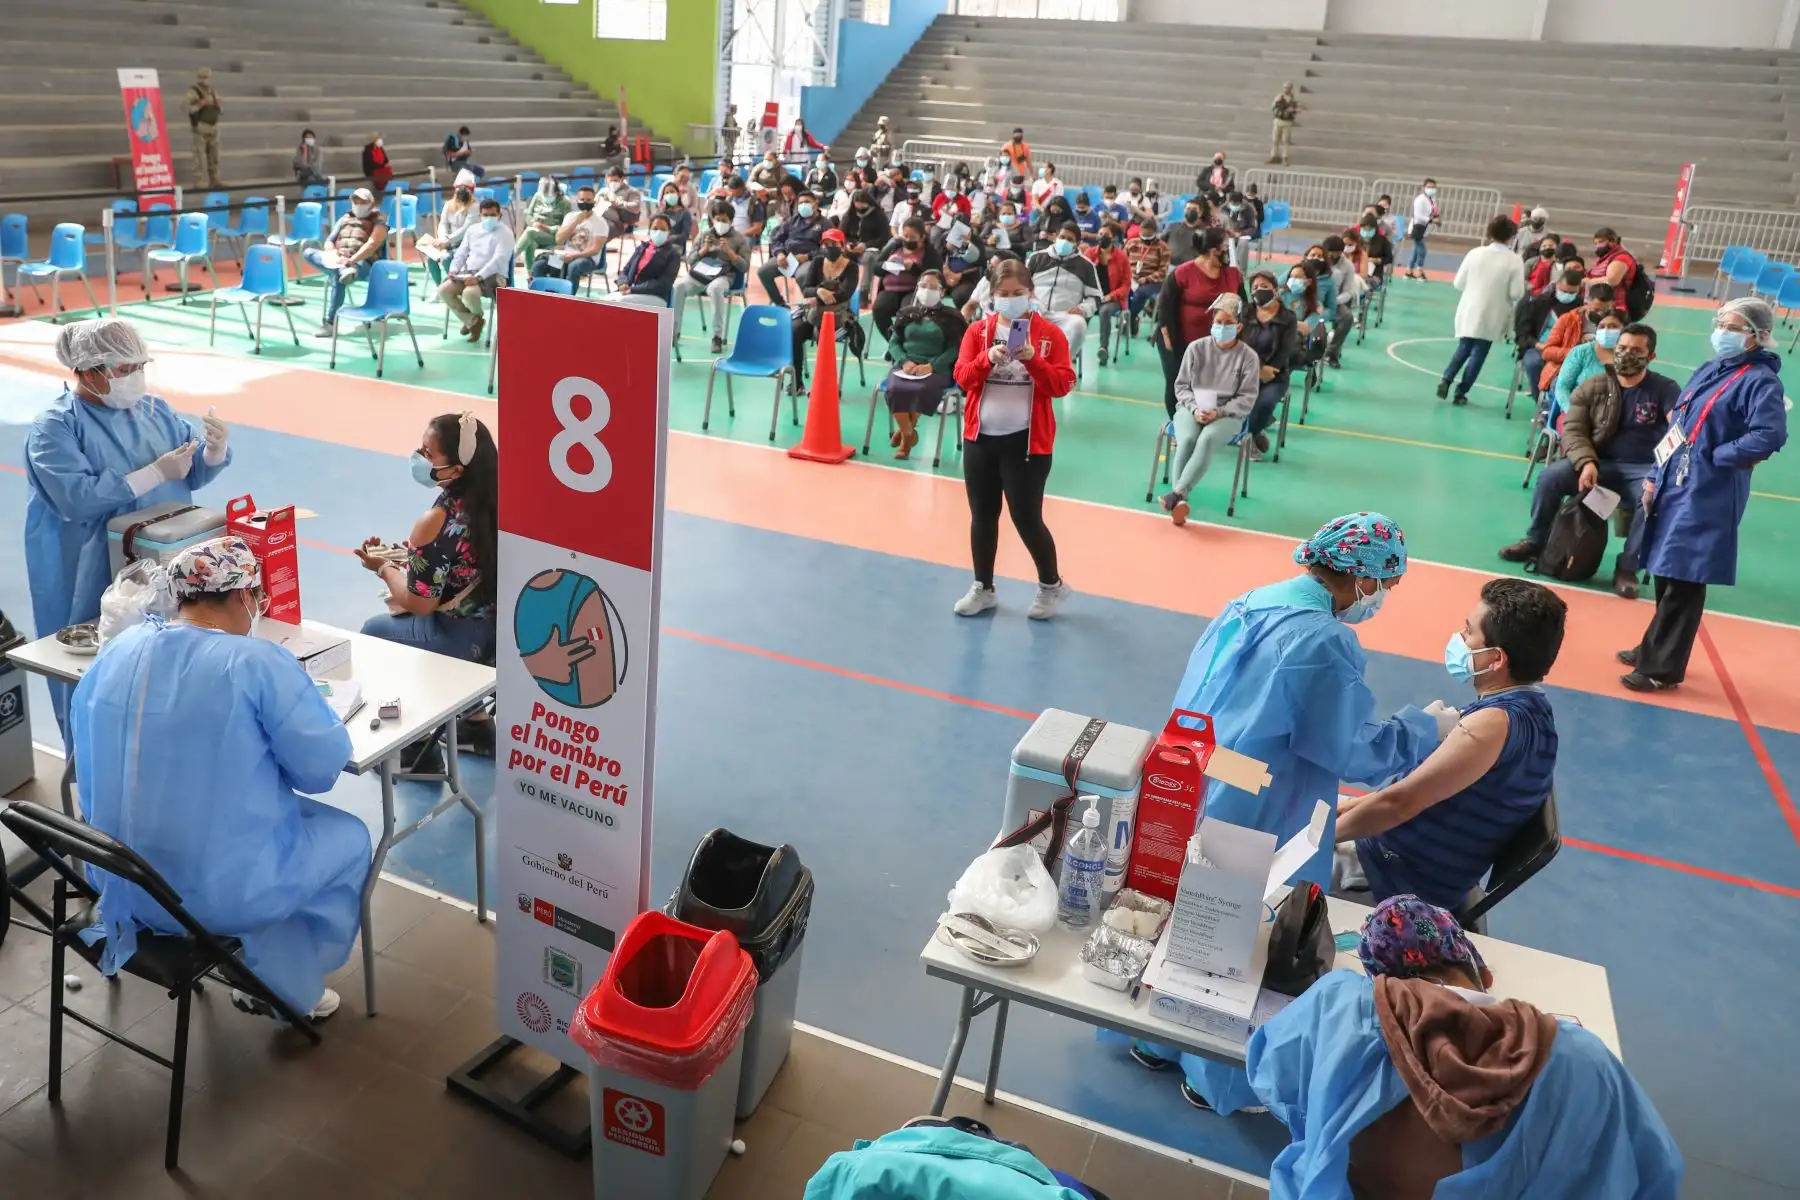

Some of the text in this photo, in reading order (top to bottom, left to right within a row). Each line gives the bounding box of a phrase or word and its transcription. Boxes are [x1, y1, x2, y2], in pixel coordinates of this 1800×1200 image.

[548, 376, 613, 493] 8
[530, 701, 600, 744] Pongo
[510, 723, 622, 777] el hombro
[508, 748, 629, 807] por el Perú
[519, 781, 614, 827] YO ME VACUNO
[522, 855, 609, 899] Gobierno del Perú
